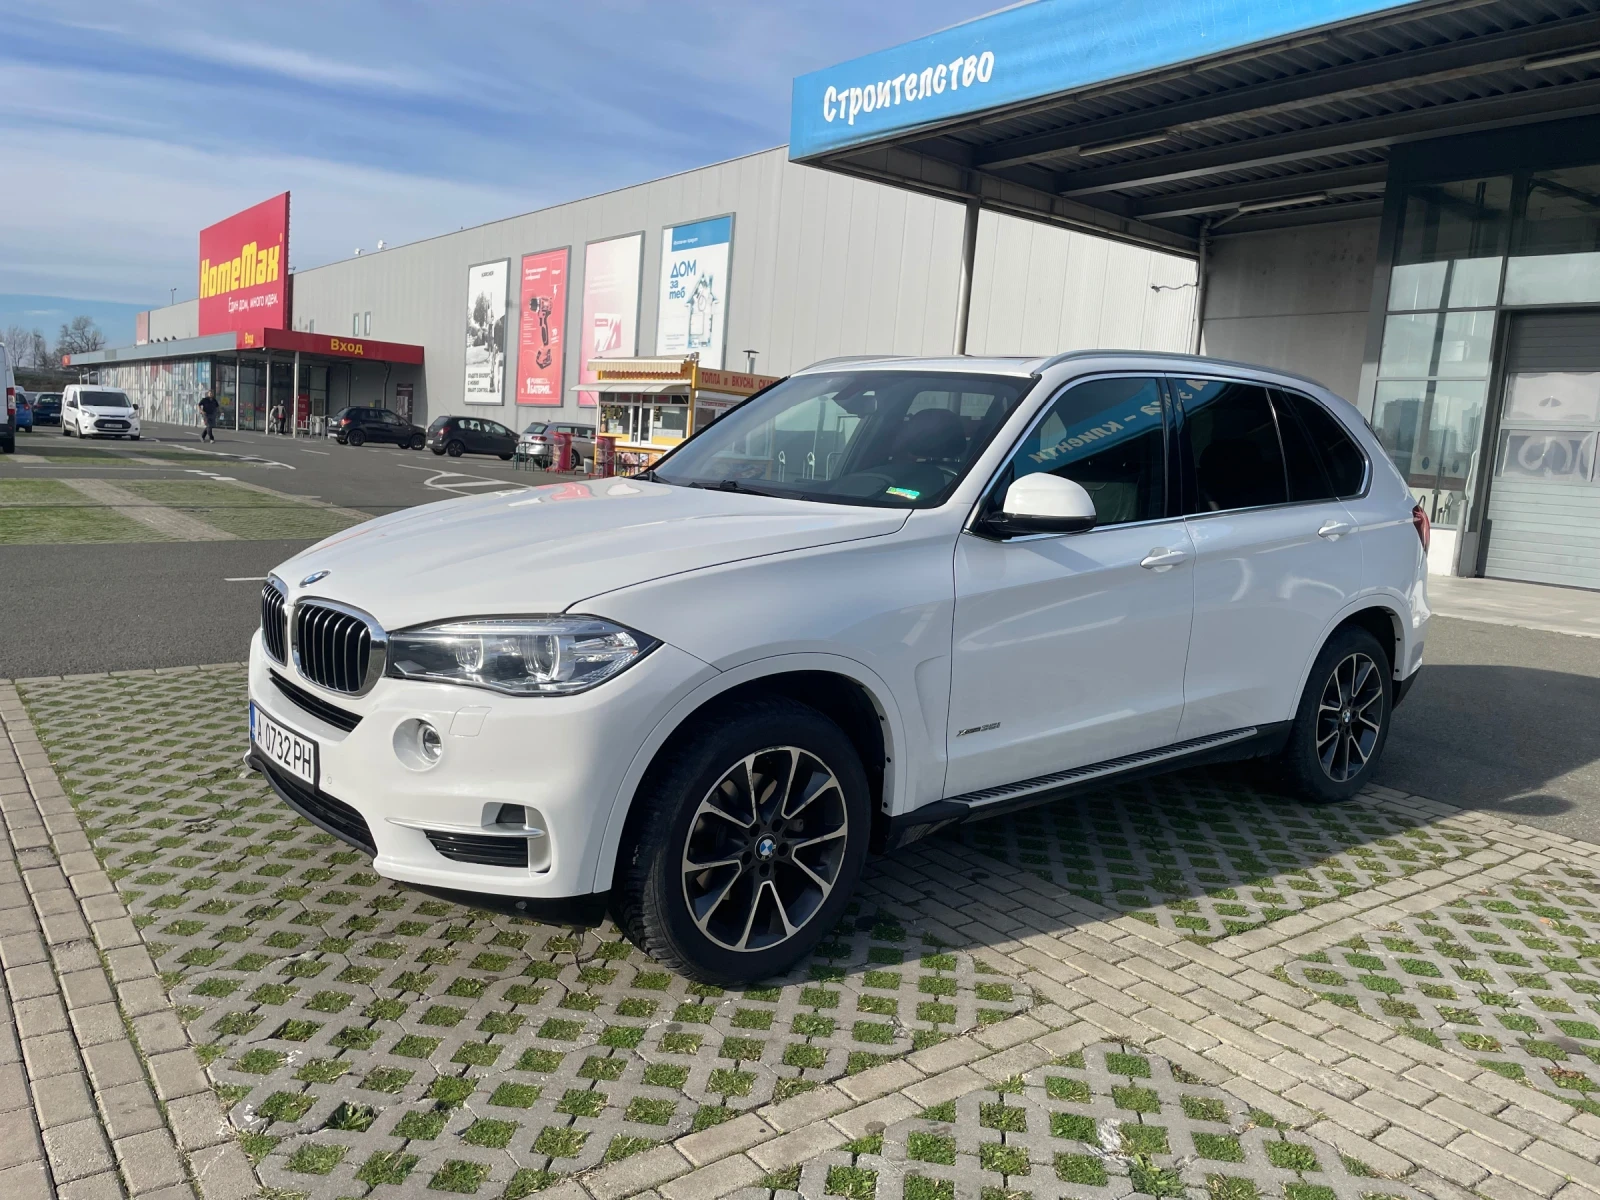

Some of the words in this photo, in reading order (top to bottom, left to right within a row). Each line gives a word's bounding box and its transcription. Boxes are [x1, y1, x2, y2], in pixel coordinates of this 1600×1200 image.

[823, 51, 995, 125] Строителство
[200, 241, 280, 299] HomeMax
[670, 260, 697, 278] ДОМ
[670, 280, 679, 289] за
[331, 338, 363, 355] Вход
[701, 371, 721, 386] ТОПЛА
[731, 375, 754, 389] ВКУСНА
